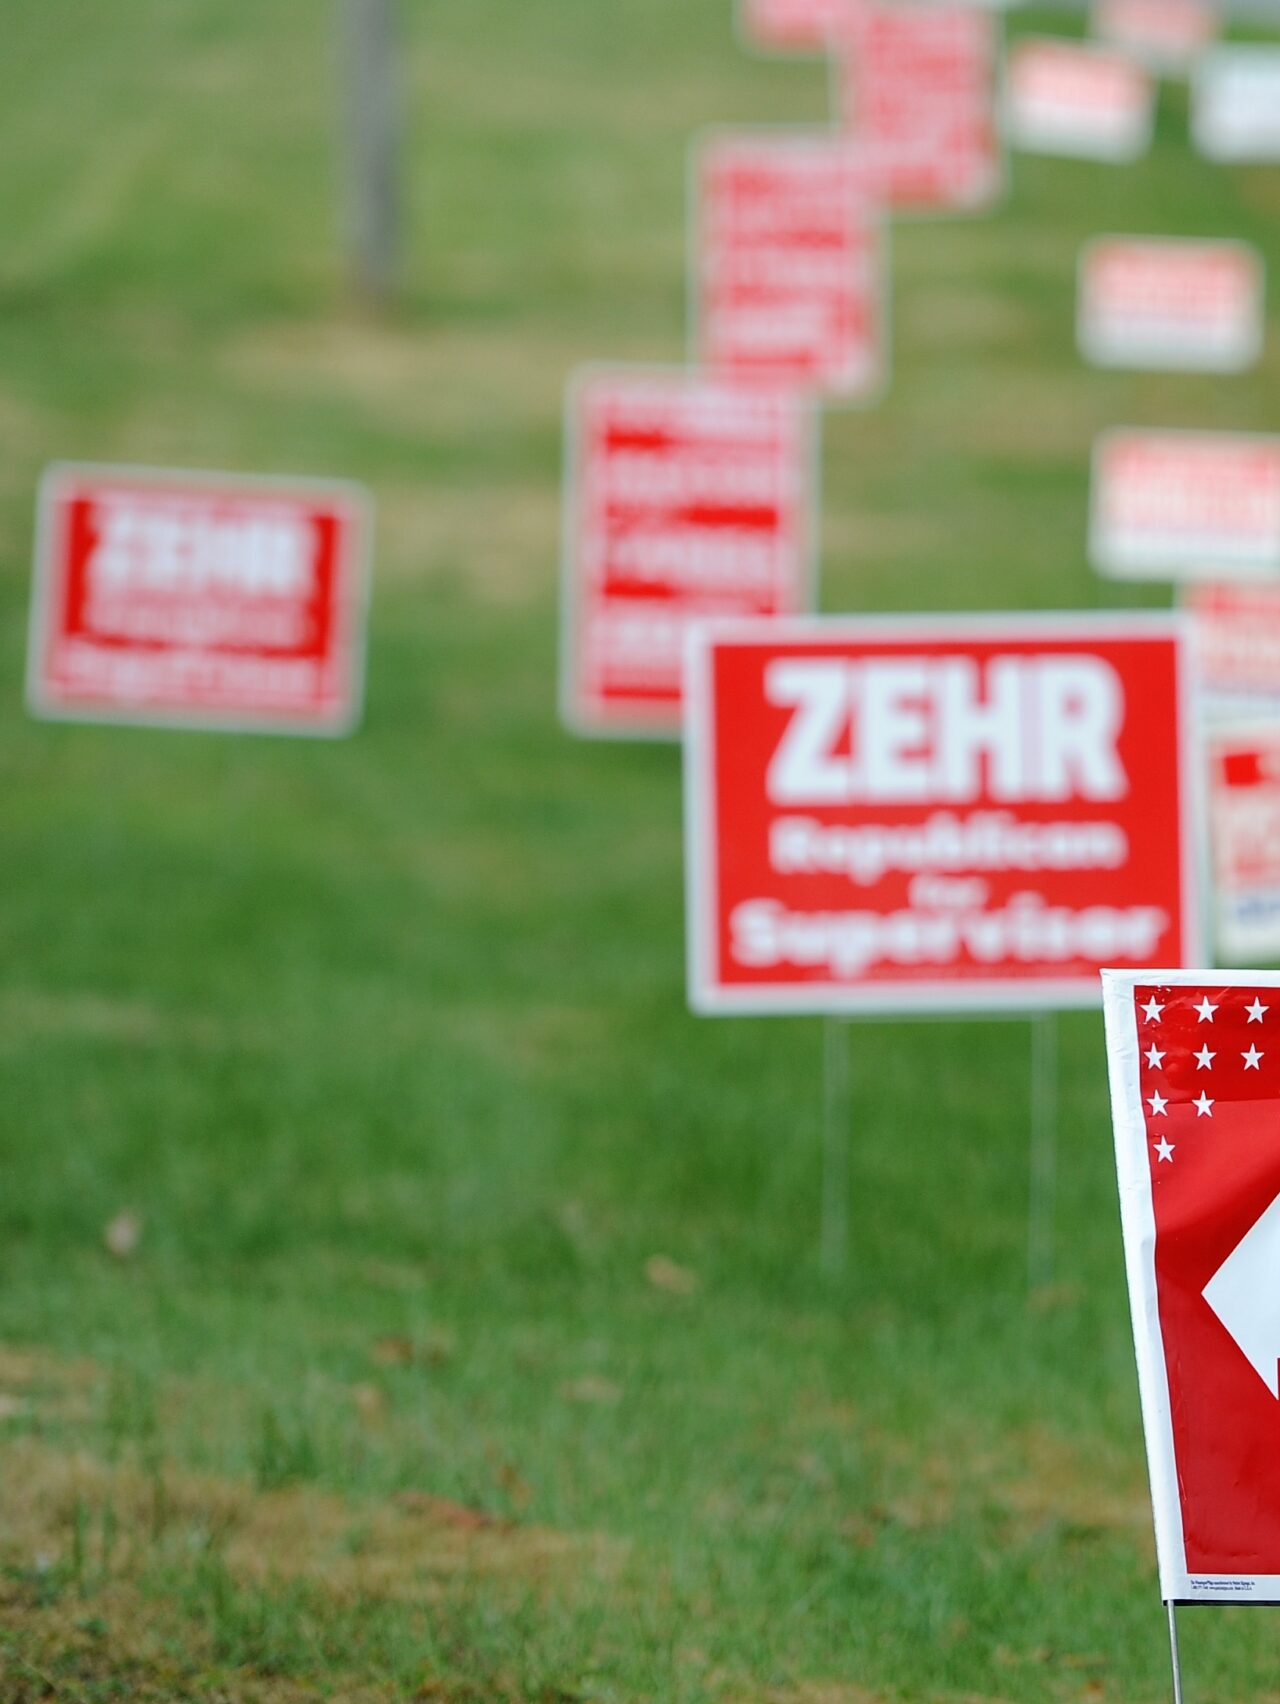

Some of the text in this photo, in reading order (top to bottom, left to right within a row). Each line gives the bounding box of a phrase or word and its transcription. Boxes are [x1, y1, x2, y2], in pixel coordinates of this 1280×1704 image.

[765, 654, 1128, 806] ZEHR
[768, 811, 1128, 886] Republican
[728, 891, 1169, 980] Supervisor
